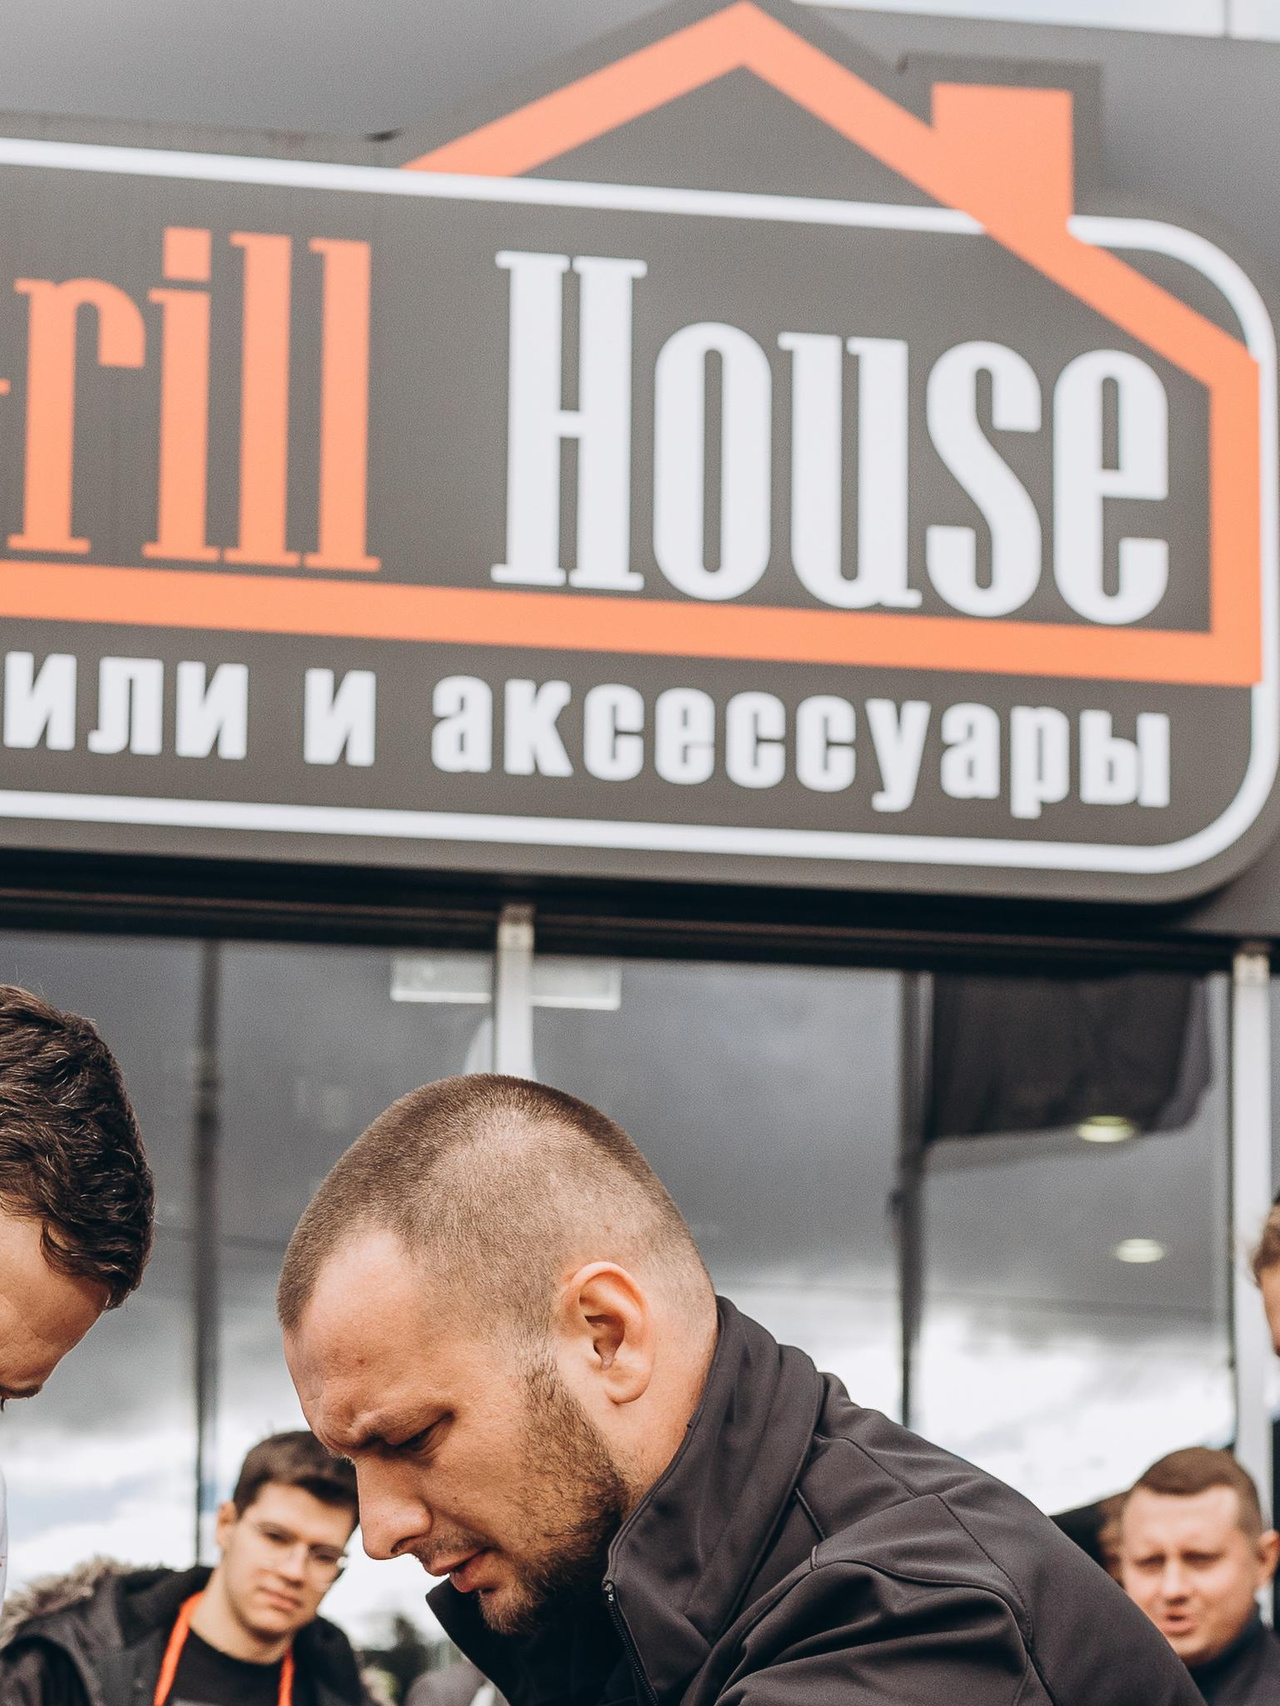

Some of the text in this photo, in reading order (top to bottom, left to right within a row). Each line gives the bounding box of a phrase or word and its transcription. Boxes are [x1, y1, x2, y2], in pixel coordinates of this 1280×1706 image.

[490, 250, 1169, 625] House
[303, 667, 377, 767] и
[430, 675, 1170, 820] аксессуары
